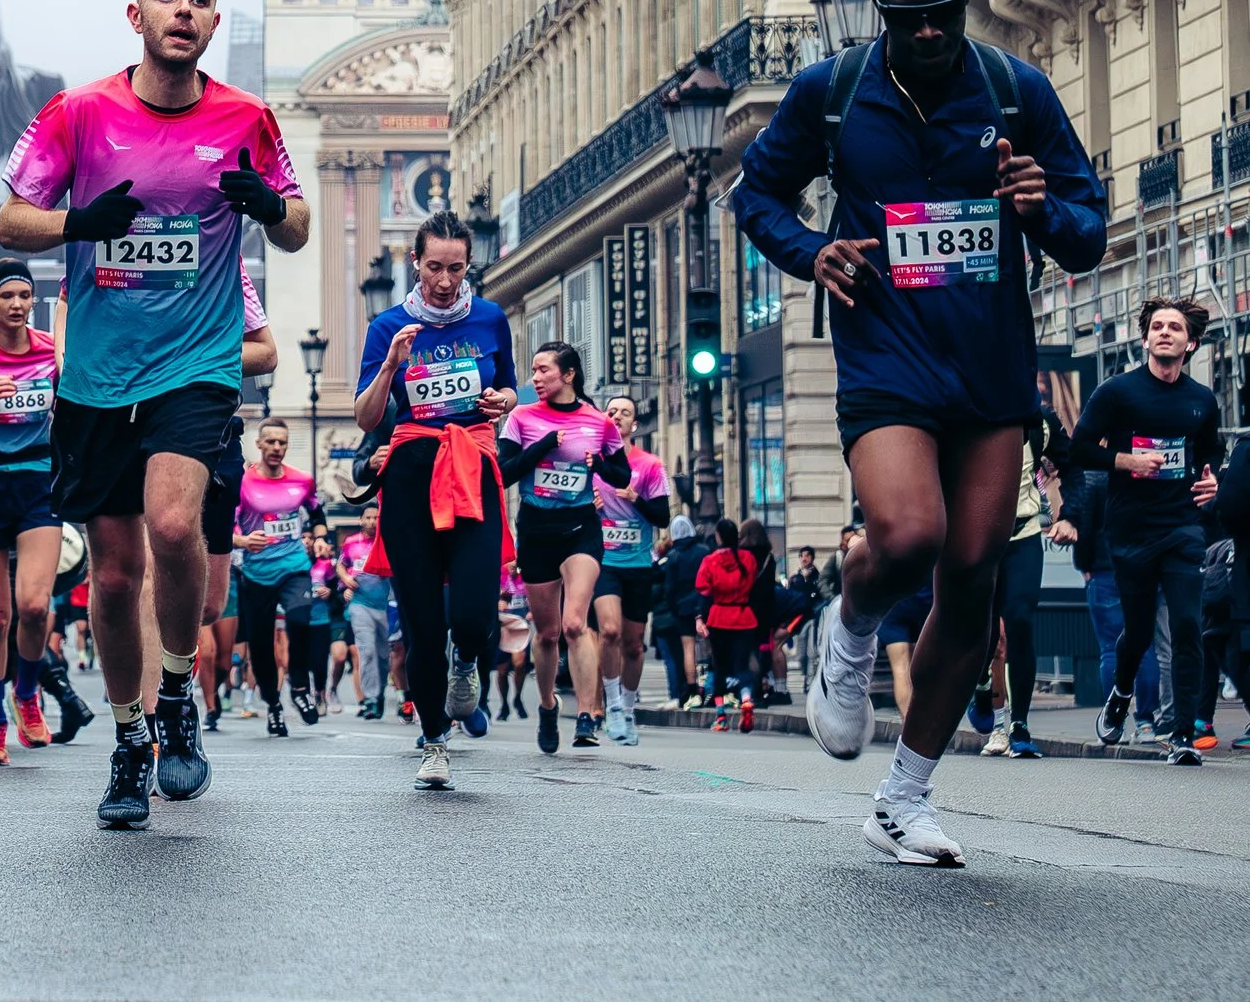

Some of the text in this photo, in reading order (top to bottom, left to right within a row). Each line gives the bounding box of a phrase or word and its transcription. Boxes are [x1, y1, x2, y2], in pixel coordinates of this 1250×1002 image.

[969, 204, 994, 214] HOKA
[169, 219, 193, 229] HOKA
[895, 226, 994, 257] 11838
[102, 238, 194, 264] 12432
[912, 266, 924, 274] FLY
[924, 265, 945, 273] PARIS
[895, 277, 929, 285] 17.11.2024
[415, 376, 471, 400] 9550
[4, 393, 46, 409] 8868
[541, 472, 580, 487] 7387
